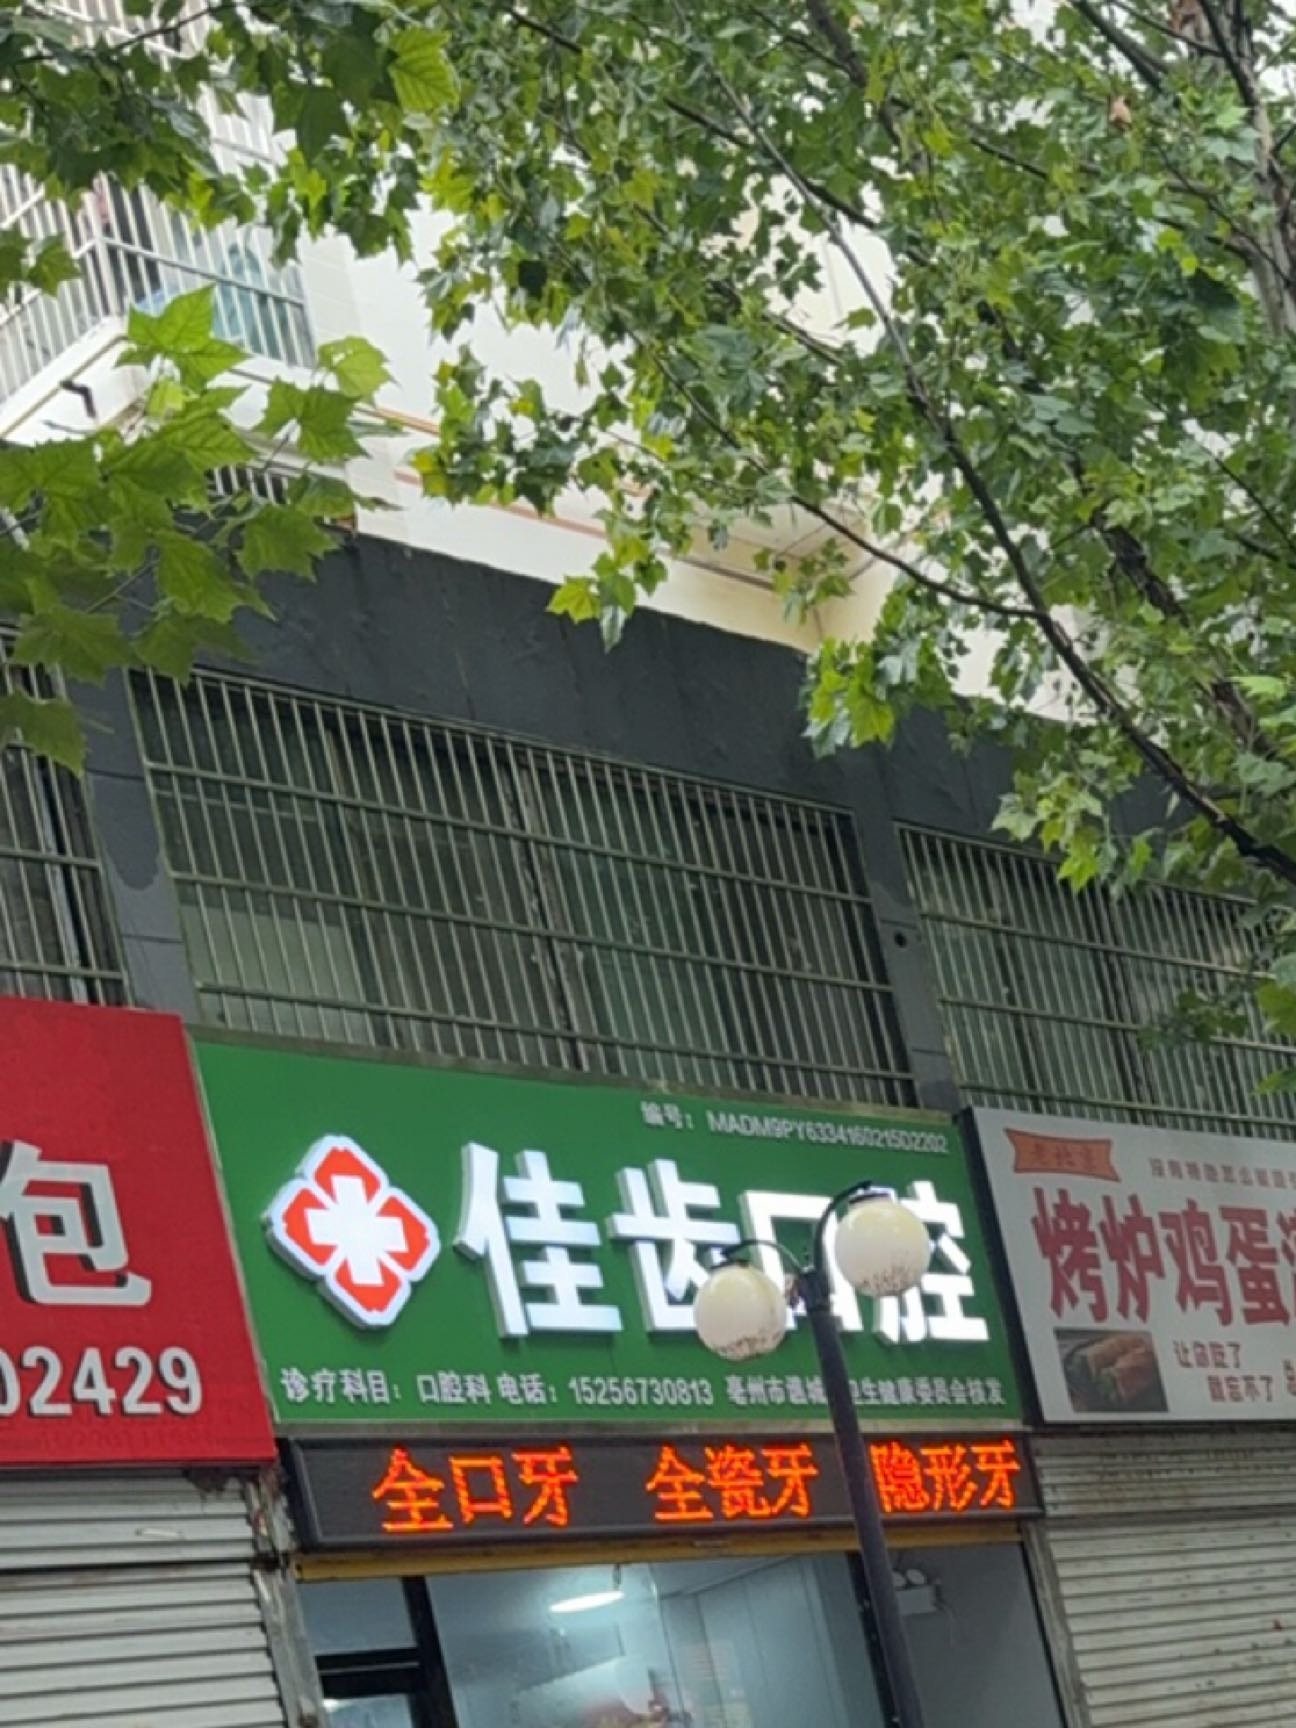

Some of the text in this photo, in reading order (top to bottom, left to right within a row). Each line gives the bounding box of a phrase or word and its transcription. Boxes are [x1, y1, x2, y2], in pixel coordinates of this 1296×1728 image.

[0, 1141, 152, 1306] 包
[453, 1143, 989, 1342] 佳齿口腔
[280, 1367, 401, 1405] 诊疗科目：
[416, 1372, 491, 1406] 口腔科
[568, 1376, 714, 1407] 15256730813
[371, 1439, 1023, 1532] 全口牙 全瓷牙 隐形牙
